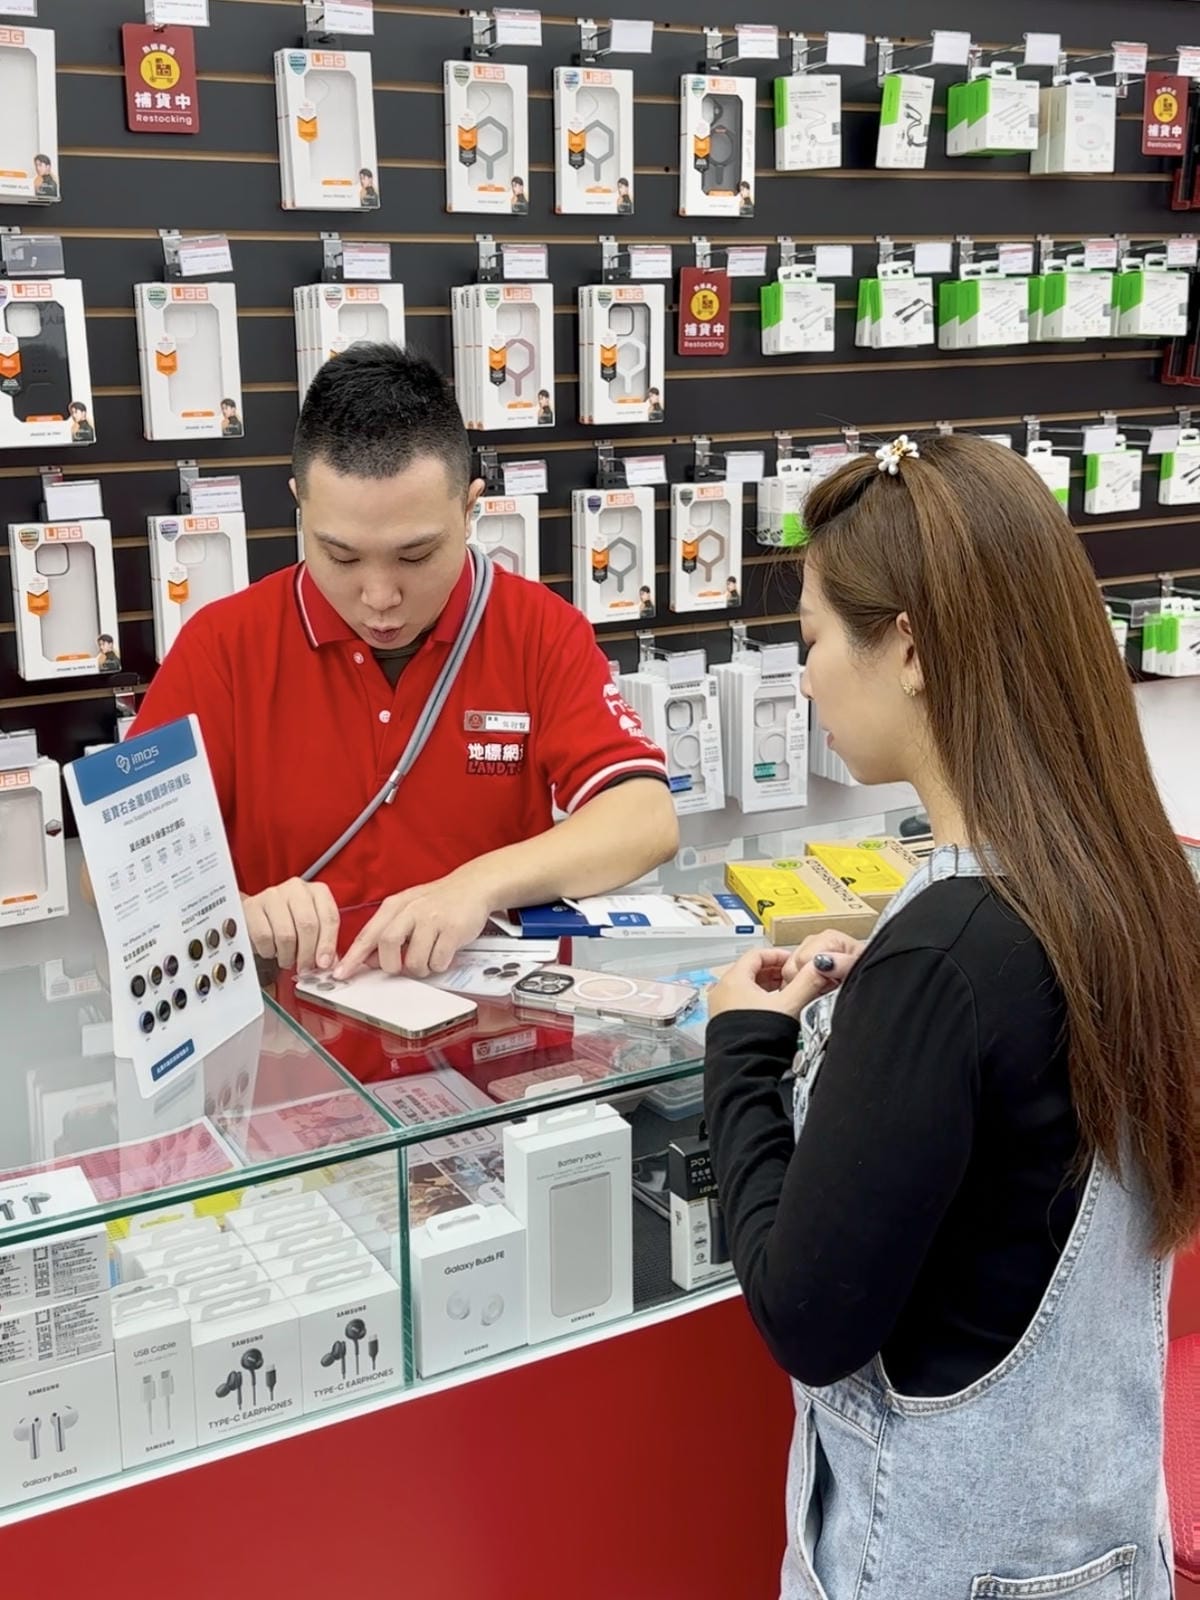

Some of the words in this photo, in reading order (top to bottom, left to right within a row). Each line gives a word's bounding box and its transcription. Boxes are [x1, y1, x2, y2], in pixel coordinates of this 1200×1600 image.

[0, 29, 25, 44] AG
[134, 91, 192, 110] 補貨中
[136, 114, 192, 126] Restocking
[684, 322, 725, 337] 補貨中
[684, 341, 724, 350] Restocking
[131, 745, 160, 765] imos
[444, 1262, 475, 1275] Galaxy
[475, 1254, 495, 1267] Buds
[496, 1250, 505, 1260] FE
[336, 1304, 367, 1318] SAMSUNG
[231, 1334, 264, 1348] SAMSUNG
[133, 1348, 149, 1358] USB
[150, 1341, 176, 1354] Cable
[28, 1383, 60, 1396] SAMSUNG
[313, 1382, 344, 1398] TYPE-C
[345, 1367, 394, 1389] EARPHONES
[208, 1413, 241, 1430] TYPE-C
[242, 1398, 293, 1420] EARPHONES
[22, 1473, 52, 1488] Galaxy
